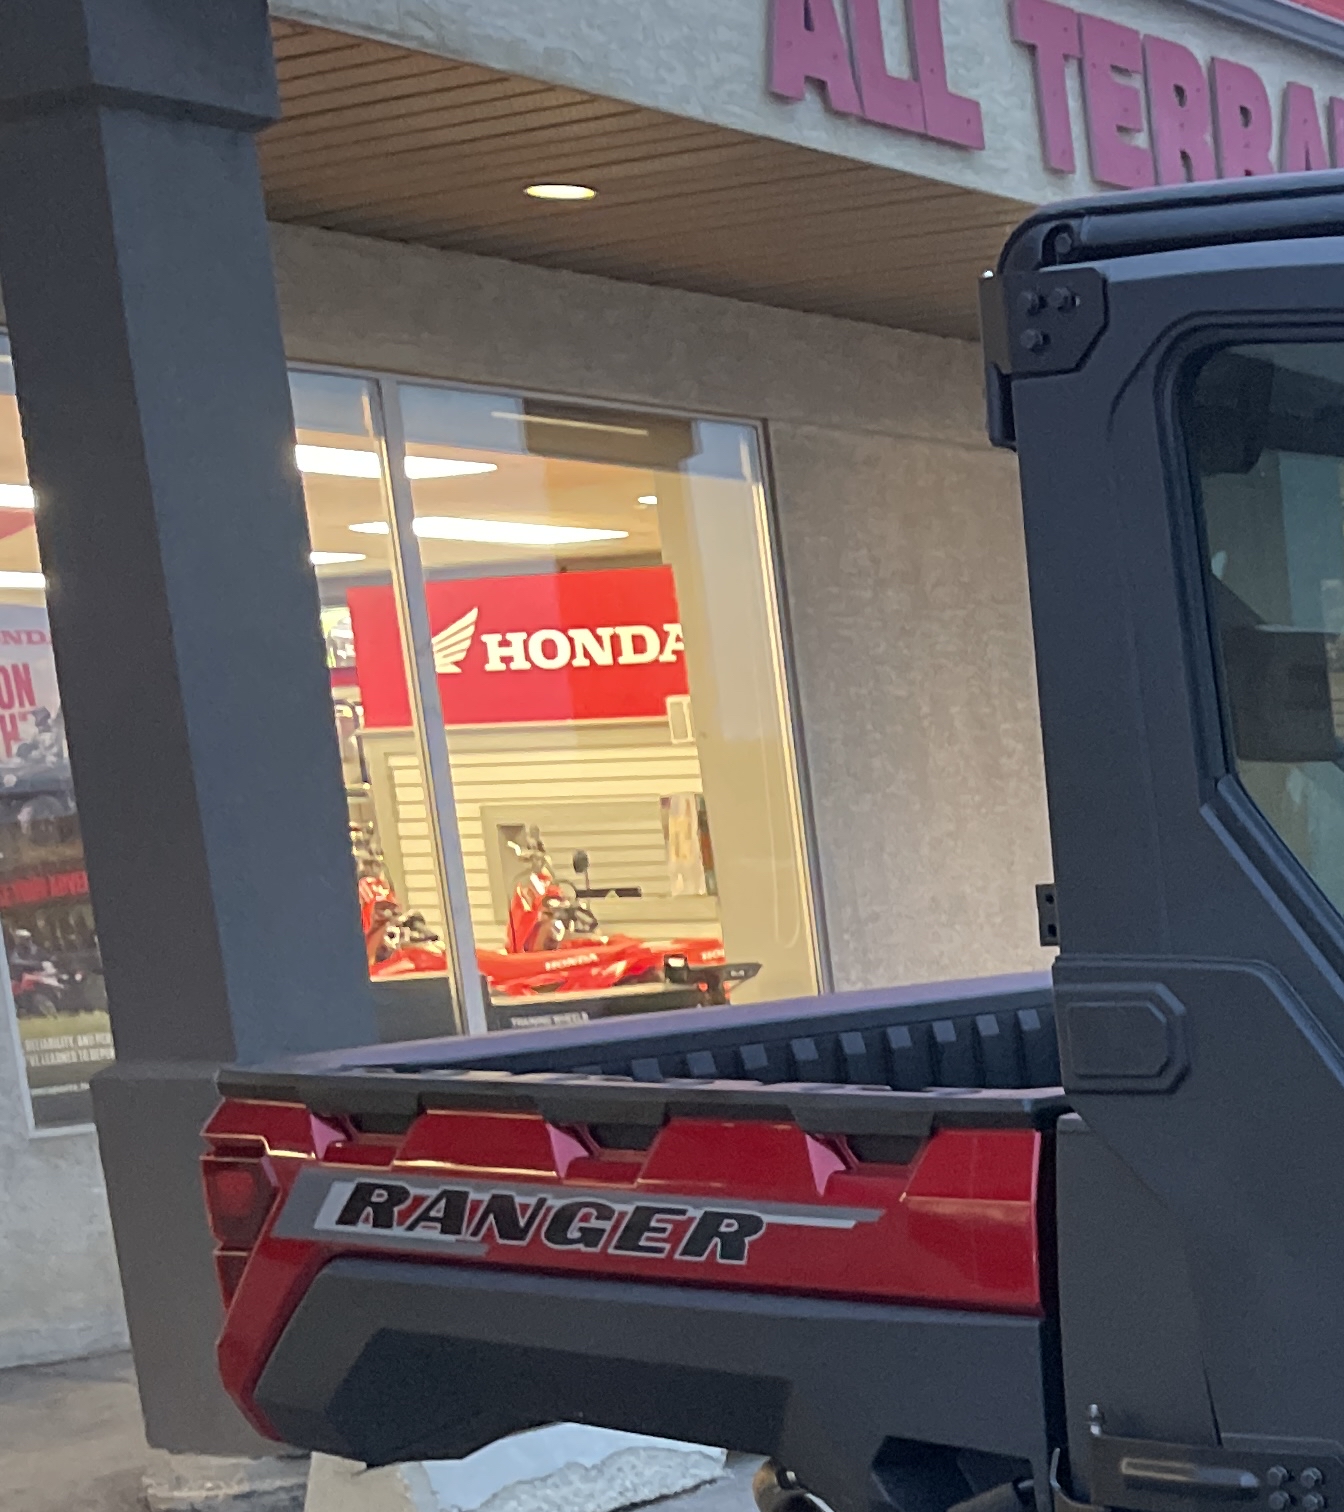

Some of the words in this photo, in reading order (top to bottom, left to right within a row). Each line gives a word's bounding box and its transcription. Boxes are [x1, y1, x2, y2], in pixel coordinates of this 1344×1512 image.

[768, 0, 985, 151] ALL
[480, 622, 685, 672] HONDA
[544, 953, 598, 972] HONDA
[335, 1180, 767, 1265] RANGER
